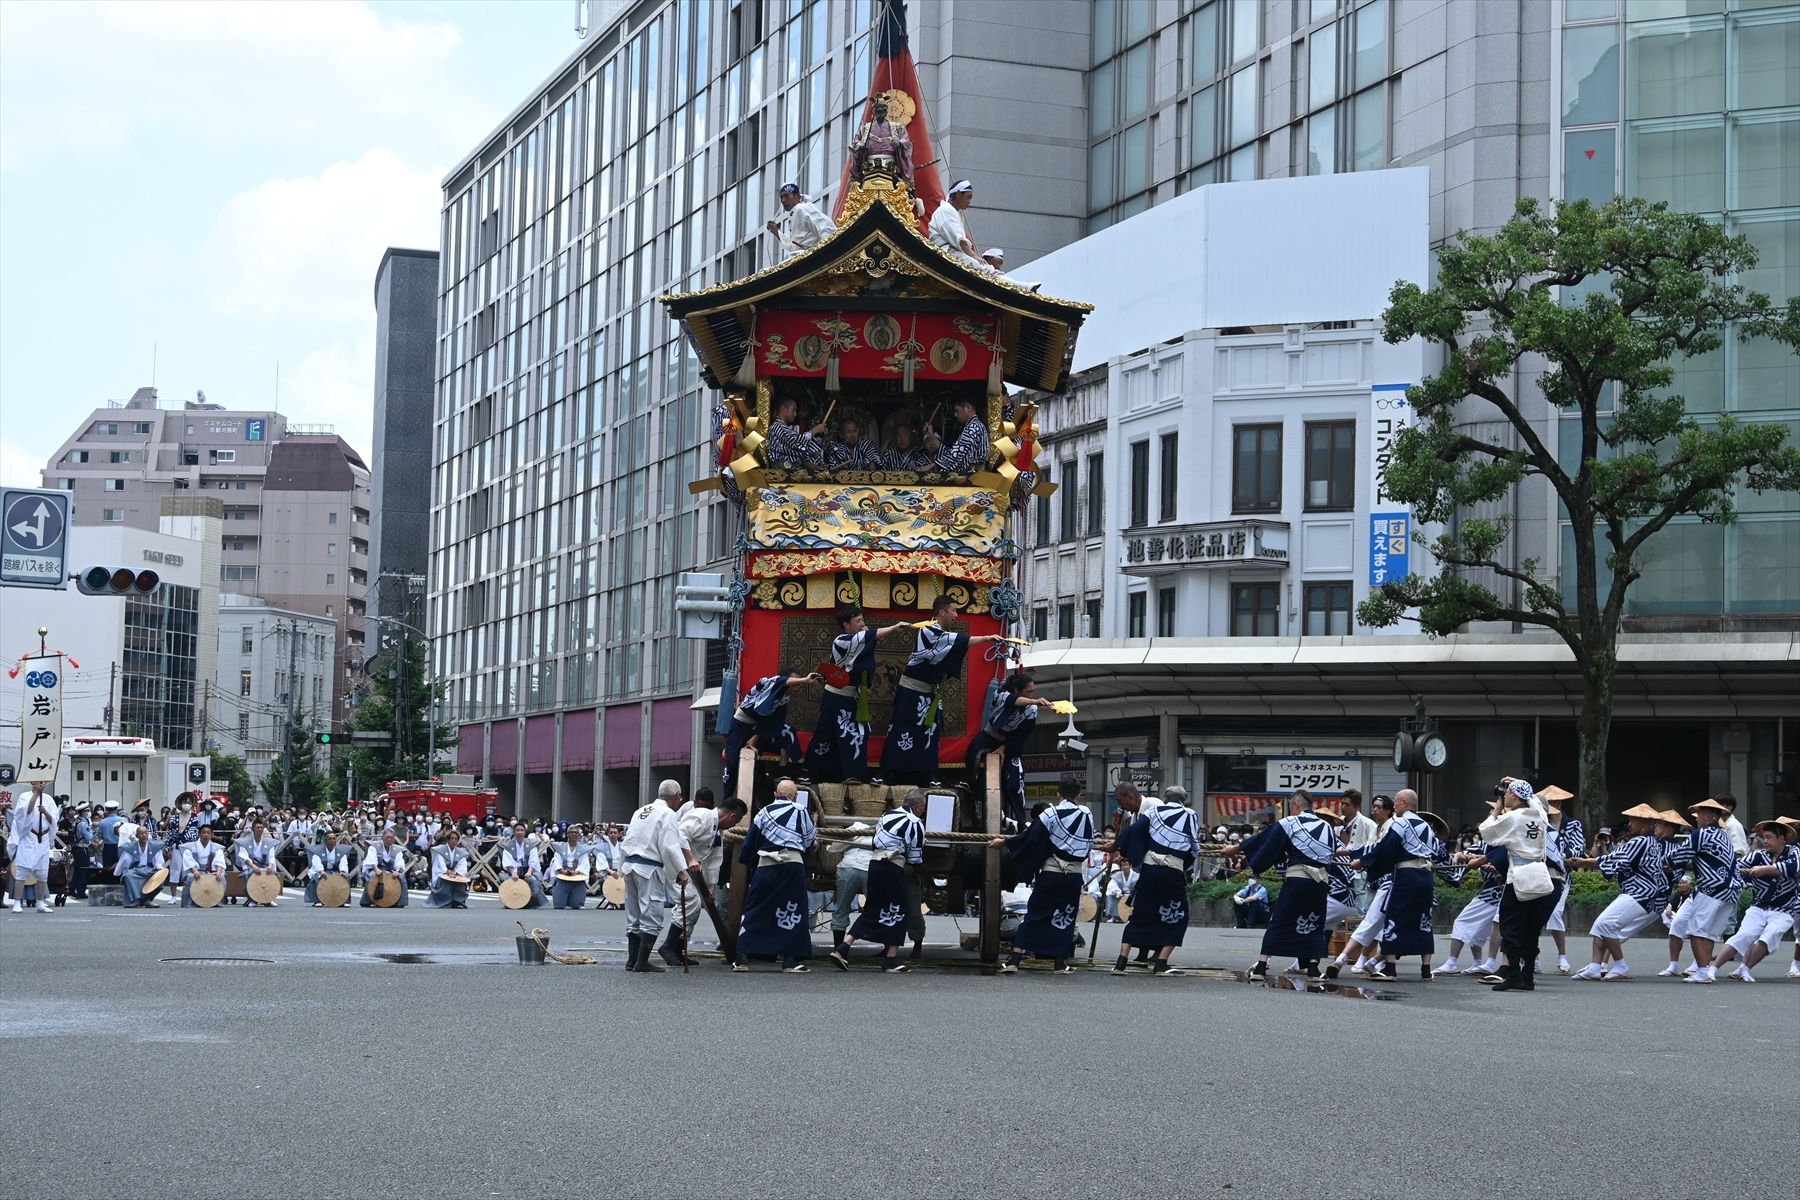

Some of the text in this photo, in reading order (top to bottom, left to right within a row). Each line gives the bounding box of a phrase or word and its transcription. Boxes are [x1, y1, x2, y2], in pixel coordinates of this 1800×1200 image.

[1126, 531, 1246, 563] 池善化粧品店
[1391, 521, 1404, 553] すぐ
[1373, 519, 1388, 583] 買えます
[3, 558, 61, 574] 路線バスを除く
[28, 694, 51, 771] 岩戸山
[1302, 763, 1350, 772] メガネスーパー
[1279, 774, 1350, 790] コンタクト
[1525, 820, 1541, 840] 岩
